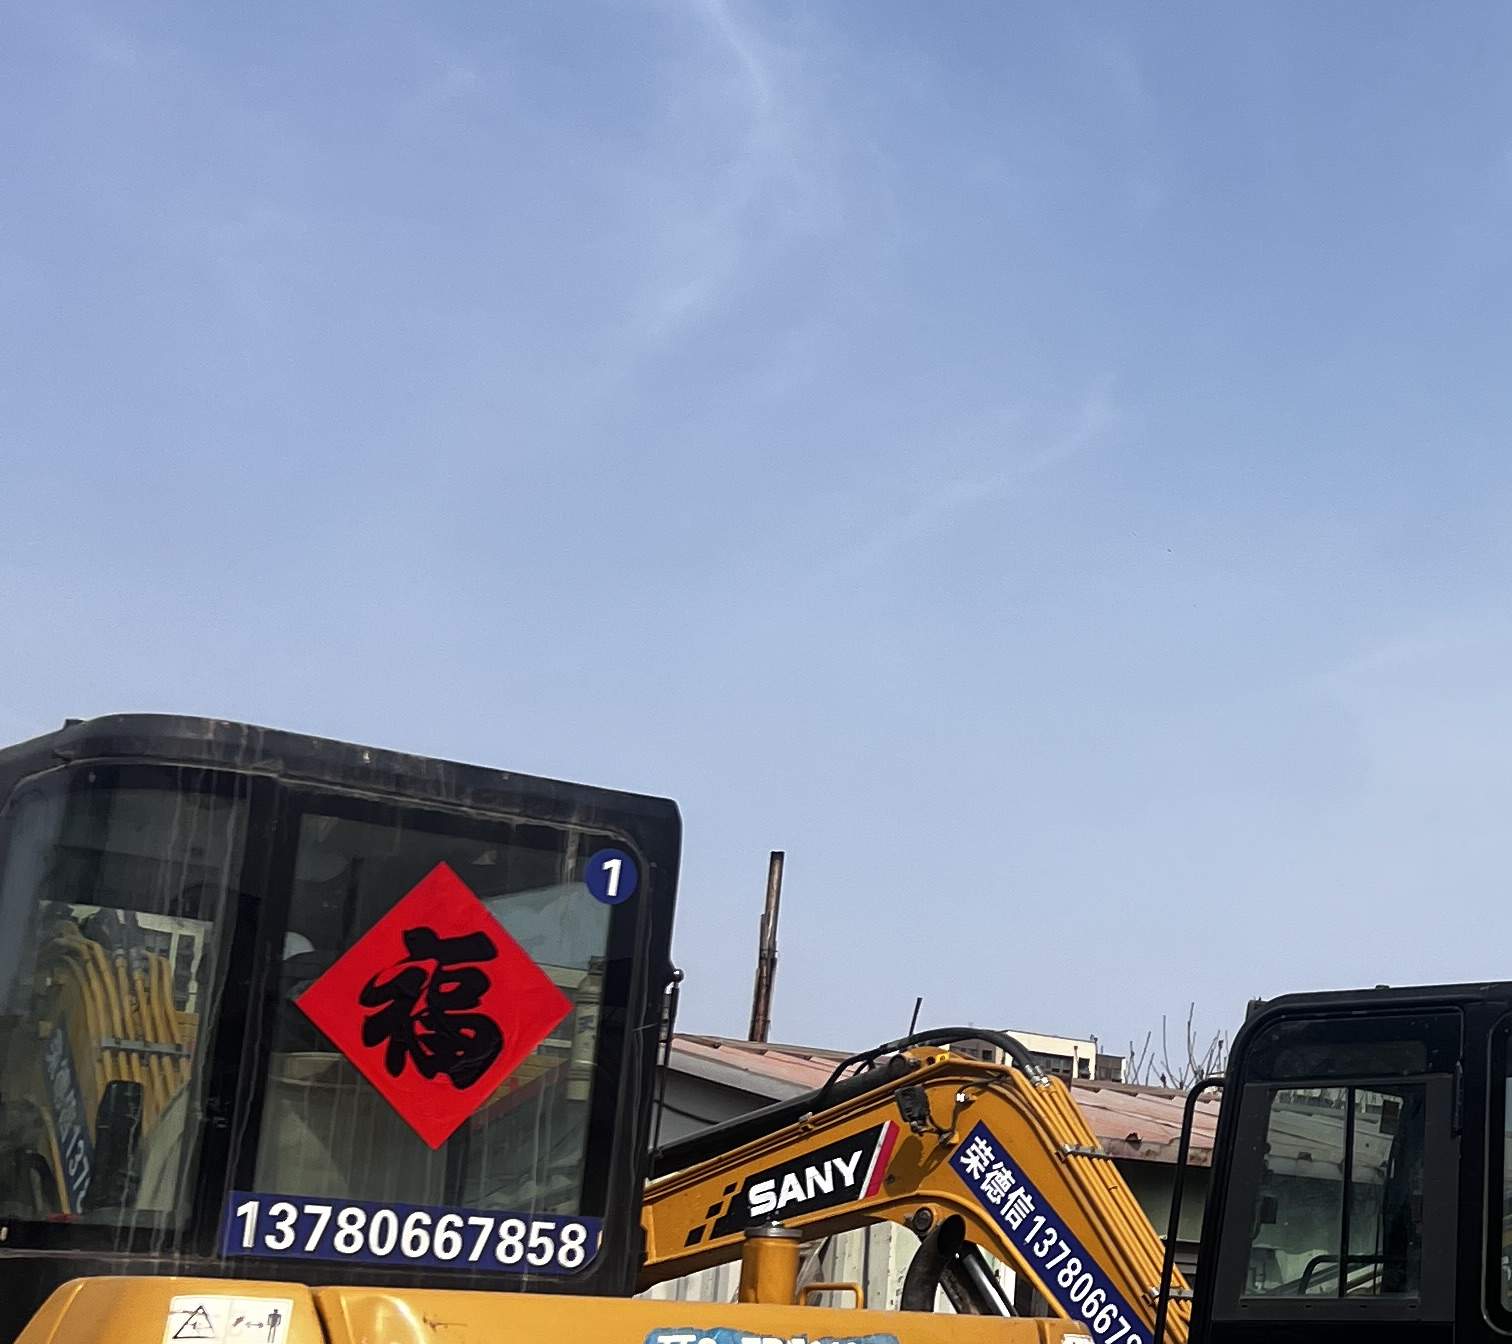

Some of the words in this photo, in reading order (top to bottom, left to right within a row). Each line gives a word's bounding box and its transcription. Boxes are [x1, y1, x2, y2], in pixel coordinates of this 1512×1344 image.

[600, 858, 624, 897] 1
[359, 927, 504, 1090] 福
[749, 1150, 863, 1217] SANY
[235, 1199, 588, 1270] 13780667858
